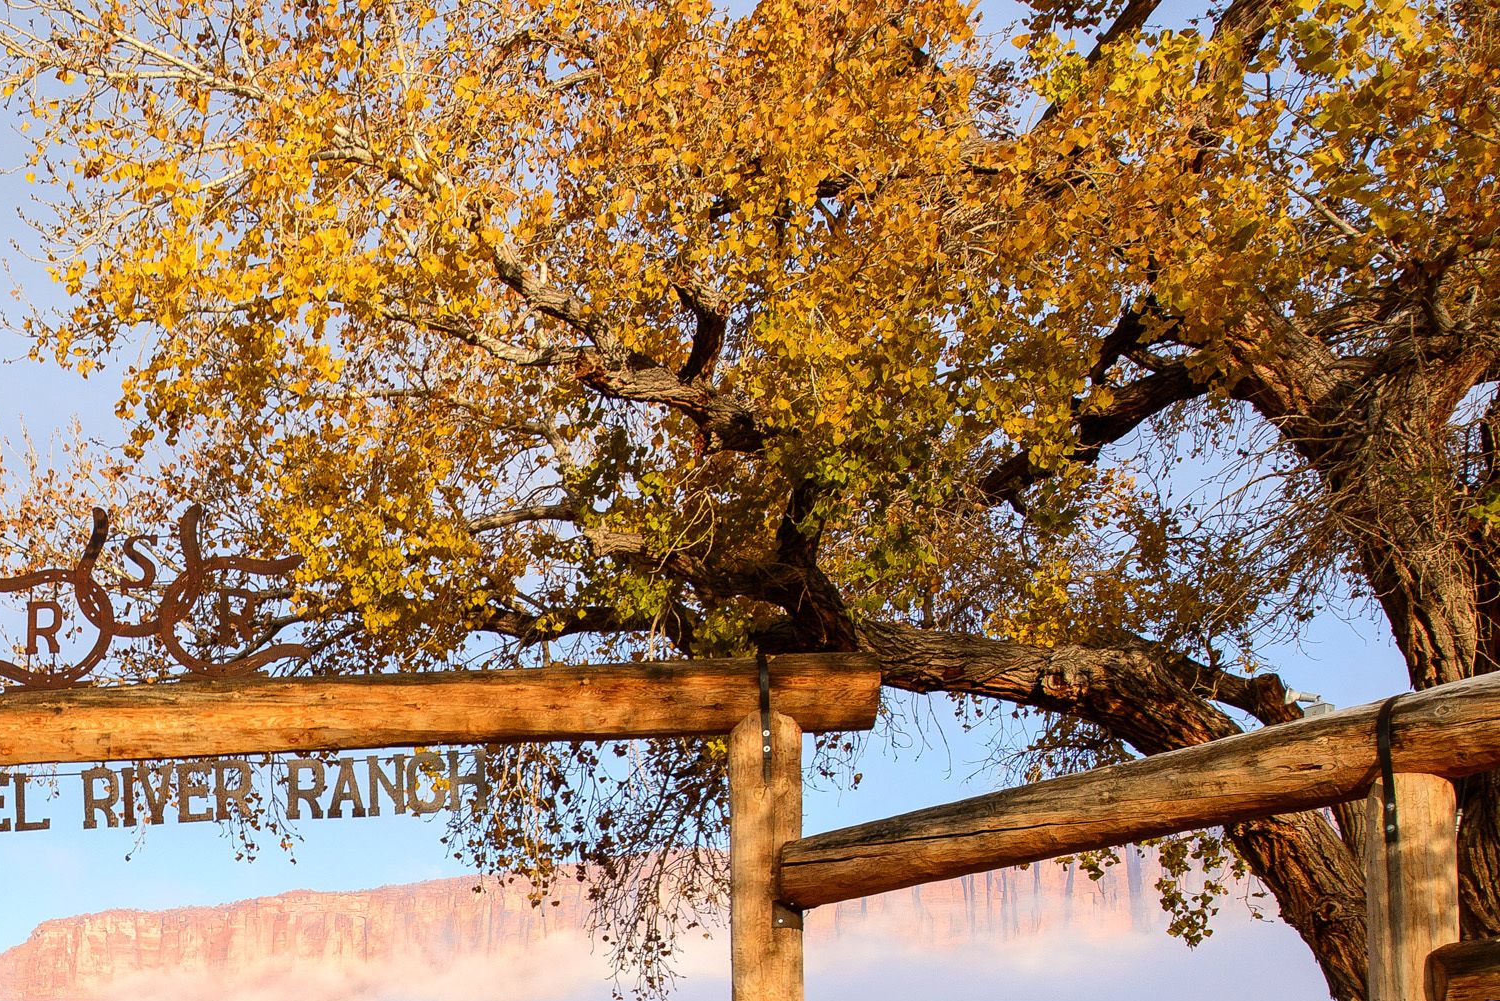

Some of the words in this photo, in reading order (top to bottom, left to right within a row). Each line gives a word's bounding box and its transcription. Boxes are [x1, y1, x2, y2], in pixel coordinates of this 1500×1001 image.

[25, 601, 63, 655] R
[82, 761, 252, 829] RIVER
[286, 749, 486, 820] RANCH
